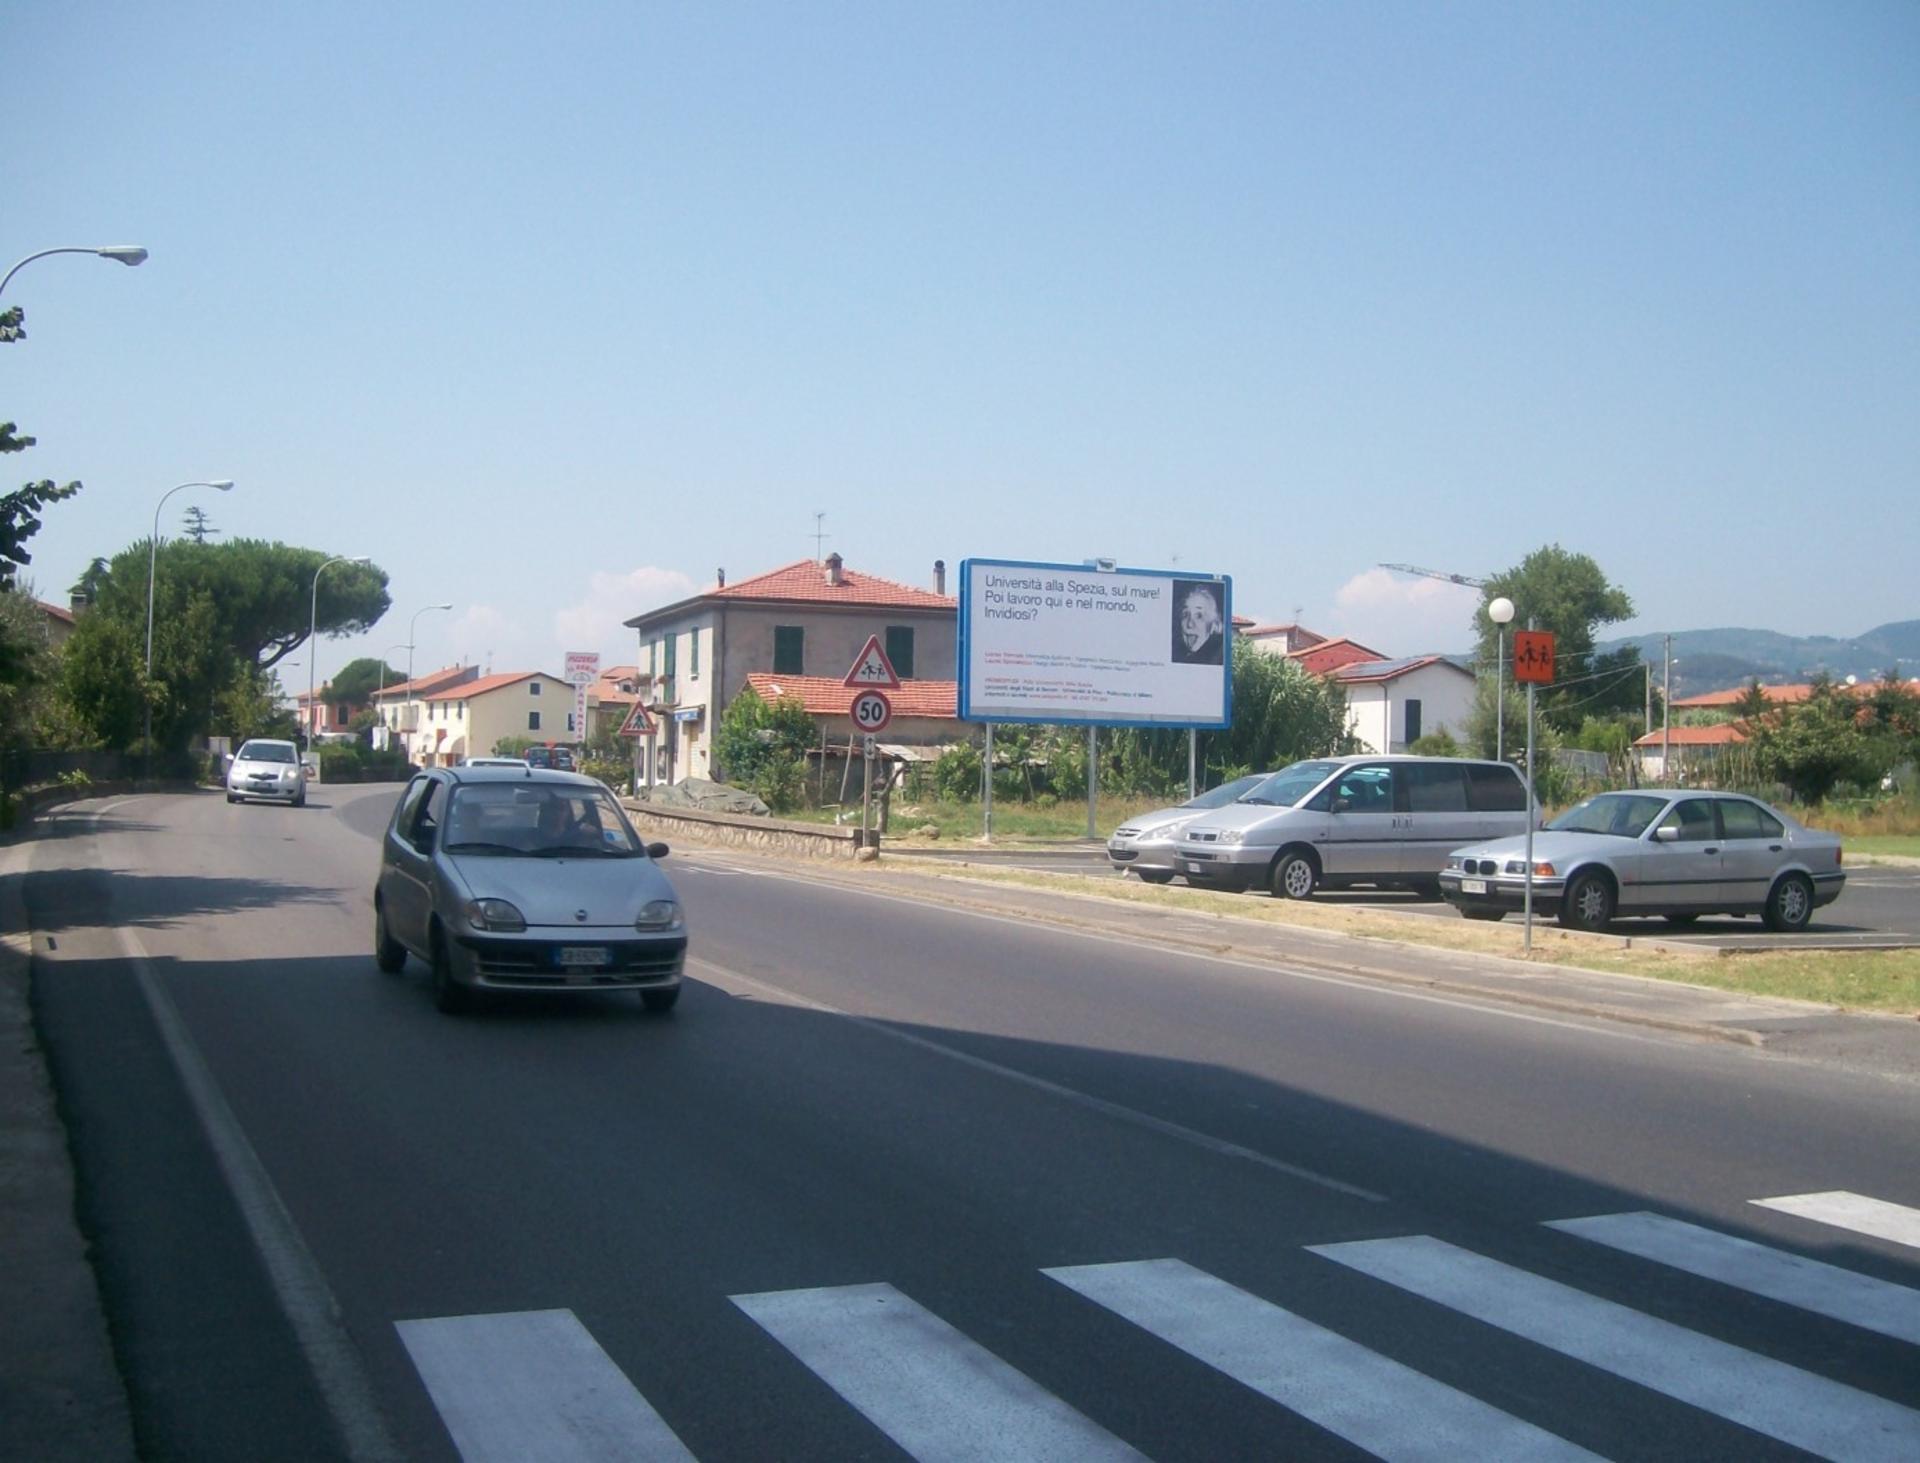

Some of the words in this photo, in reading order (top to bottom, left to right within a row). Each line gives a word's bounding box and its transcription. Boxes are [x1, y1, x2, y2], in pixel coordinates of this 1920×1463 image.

[985, 575, 1042, 591] Università
[1045, 579, 1065, 593] alla
[1067, 580, 1108, 597] Spezia,
[1111, 584, 1127, 598] sul
[1130, 587, 1161, 600] mare!
[985, 590, 1004, 603] Poi
[1007, 592, 1042, 606] lavoro
[1045, 595, 1062, 611] qui
[1065, 599, 1073, 608] e
[1076, 597, 1093, 610] nel
[1096, 599, 1138, 613] mondo.
[984, 606, 1038, 621] Invidiosi?
[860, 702, 882, 721] 50
